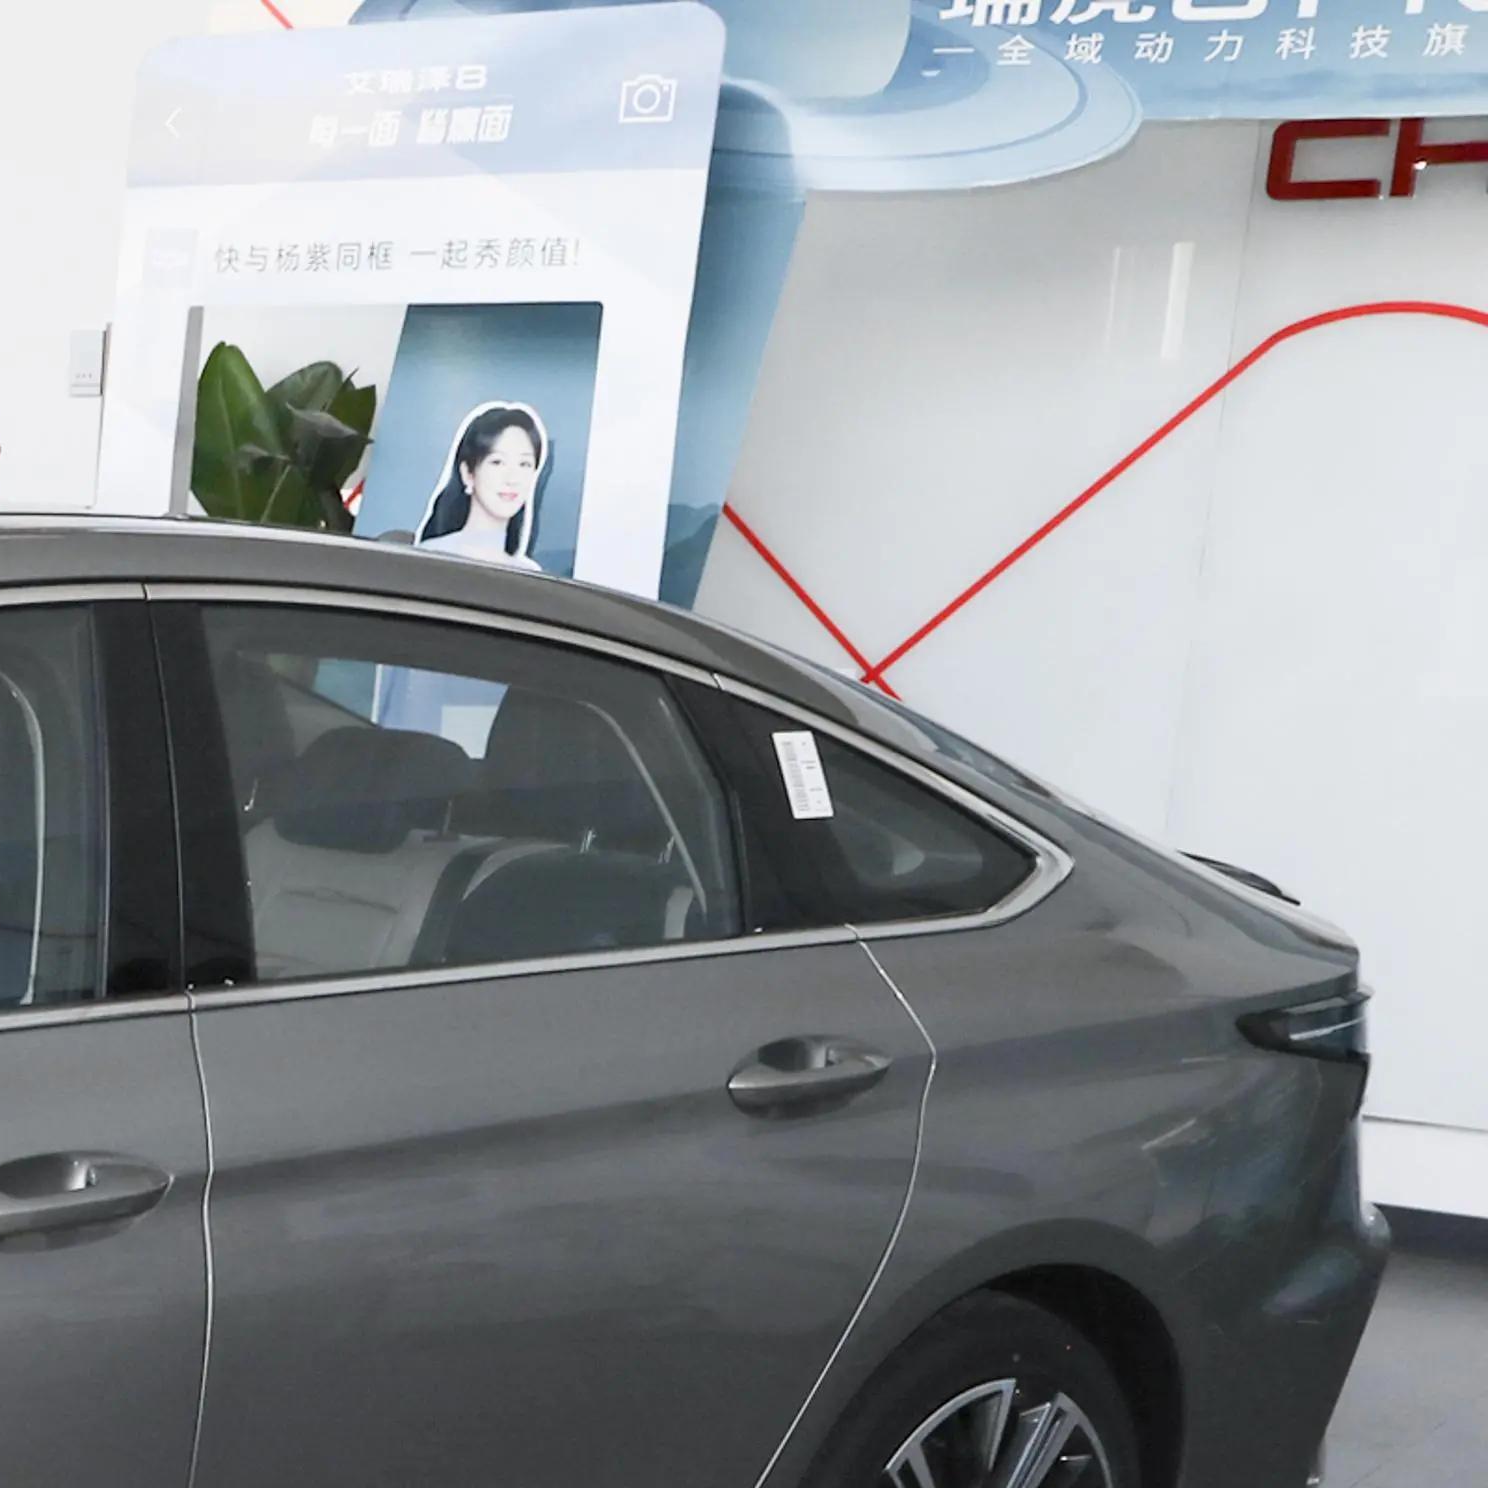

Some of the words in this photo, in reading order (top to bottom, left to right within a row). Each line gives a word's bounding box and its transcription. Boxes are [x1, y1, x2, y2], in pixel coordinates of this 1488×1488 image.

[215, 241, 395, 273] 快与杨紫同框
